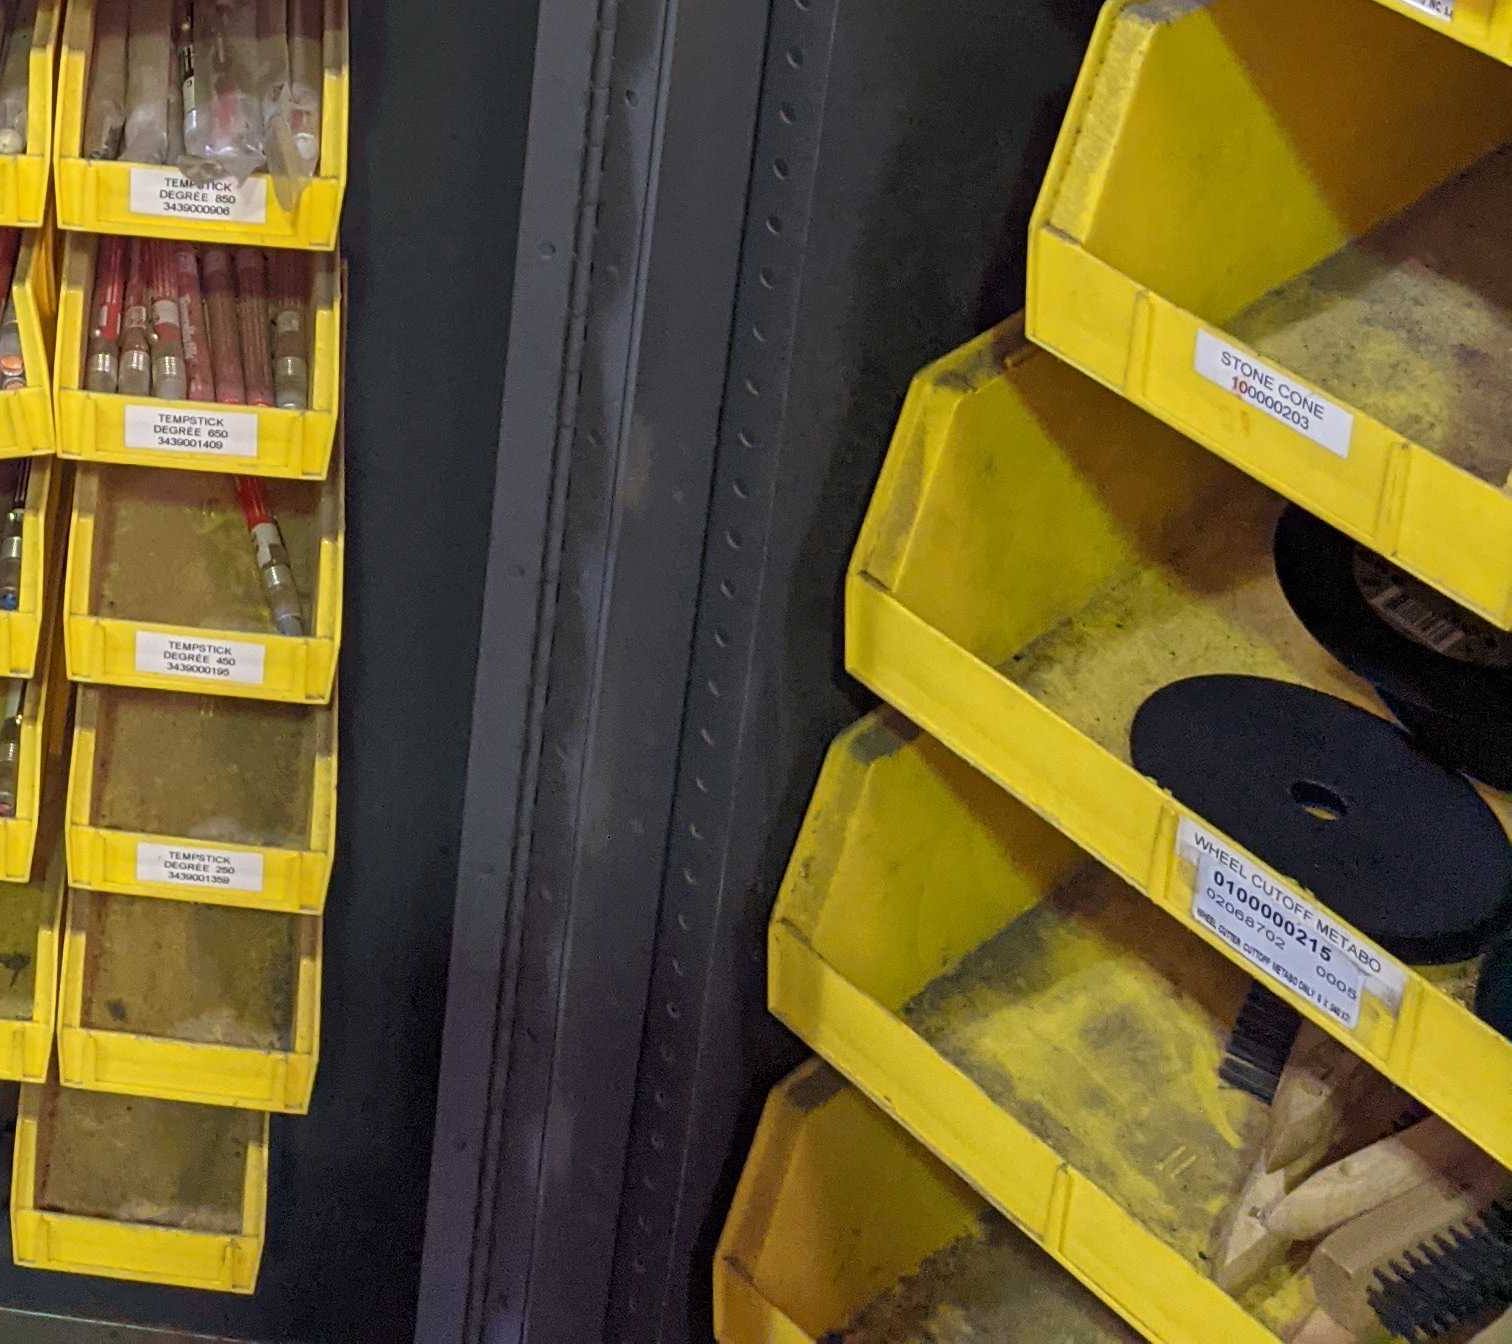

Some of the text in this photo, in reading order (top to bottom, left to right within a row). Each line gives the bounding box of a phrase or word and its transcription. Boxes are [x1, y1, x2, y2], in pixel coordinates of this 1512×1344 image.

[215, 194, 236, 204] 850
[1220, 351, 1325, 420] STONE CONE
[1231, 376, 1310, 430] 100000203
[157, 413, 224, 427] TEMPSTICK
[207, 428, 228, 439] 650
[168, 640, 232, 656] TEMPSTICK
[216, 657, 236, 666] 450
[168, 850, 231, 864] TEMPSTICK
[215, 865, 236, 875] 250
[1194, 831, 1382, 974] WHEEL CUTOFF METABO
[1206, 887, 1286, 951] 02068702
[1213, 870, 1333, 963] 0100000215
